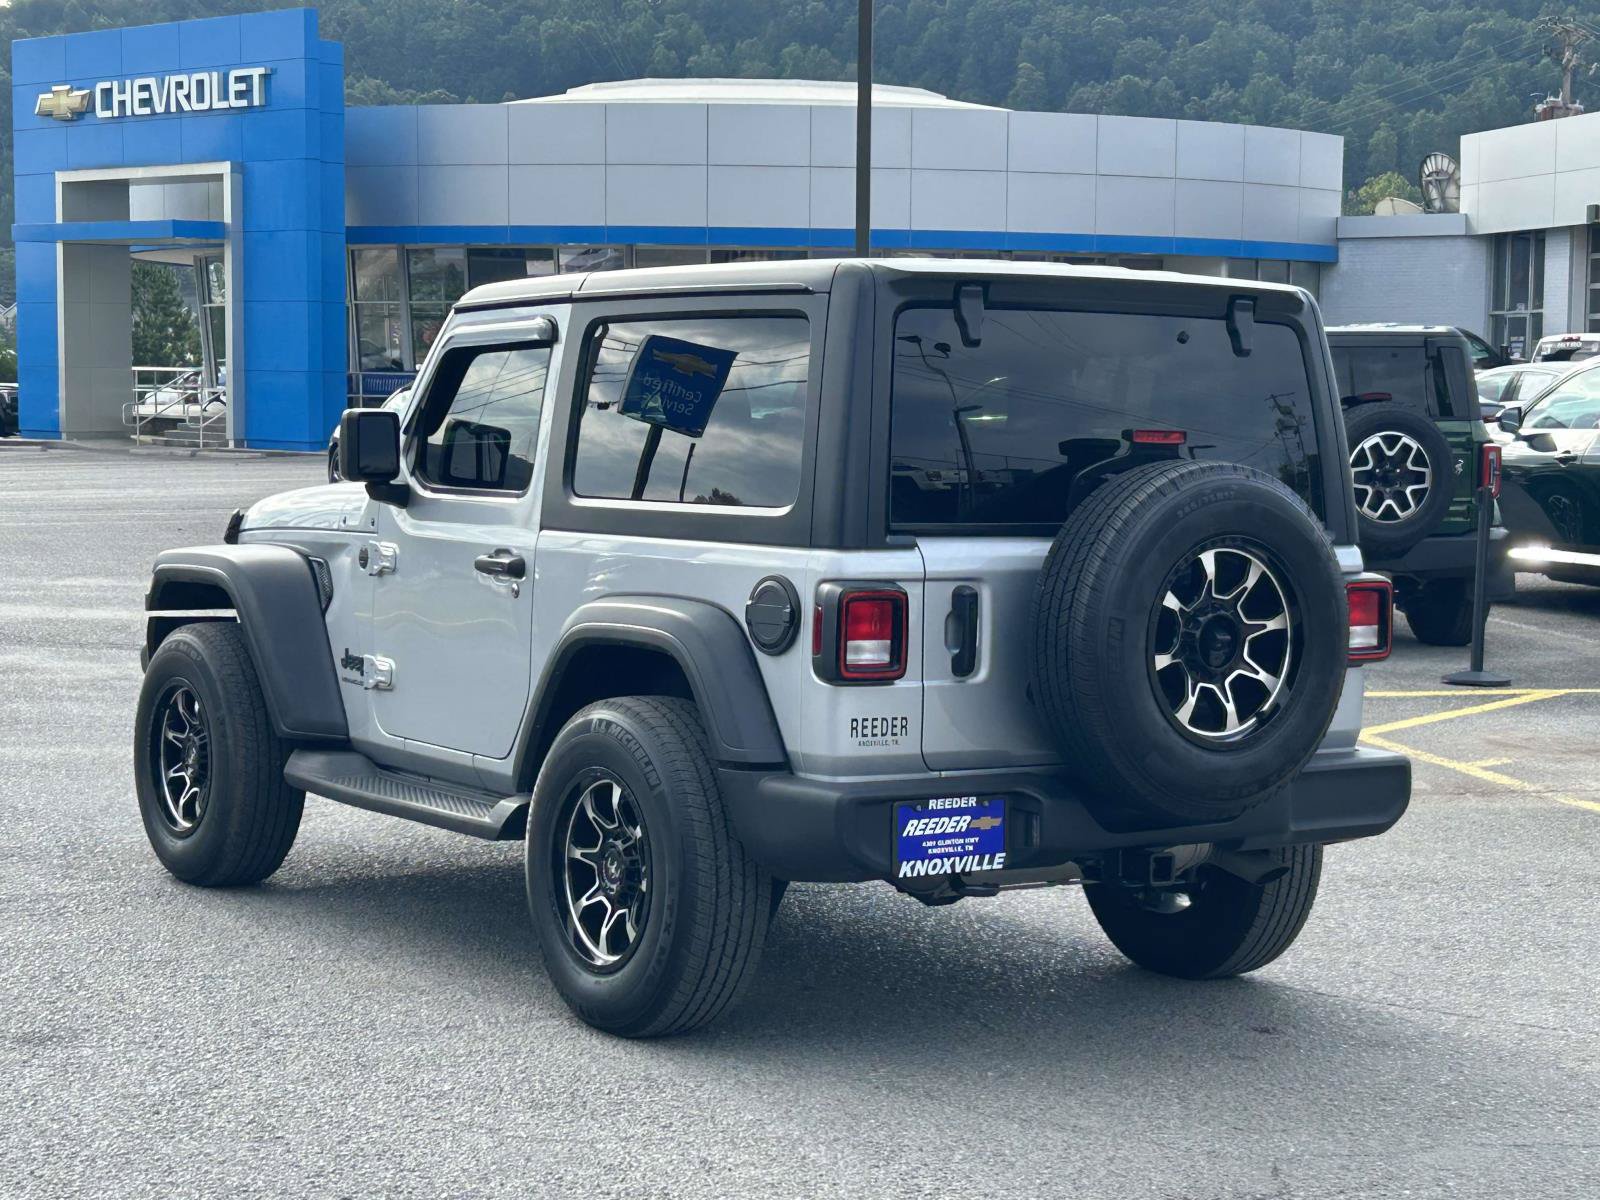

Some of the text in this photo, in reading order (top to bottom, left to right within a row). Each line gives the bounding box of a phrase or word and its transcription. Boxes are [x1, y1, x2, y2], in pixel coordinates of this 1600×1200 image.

[95, 67, 268, 118] CHEVROLET
[850, 716, 908, 739] REEDER
[607, 723, 661, 787] MICHELIN
[928, 797, 977, 810] REEDER
[902, 815, 971, 837] REEDER
[898, 853, 1006, 878] KNOXVILLE
